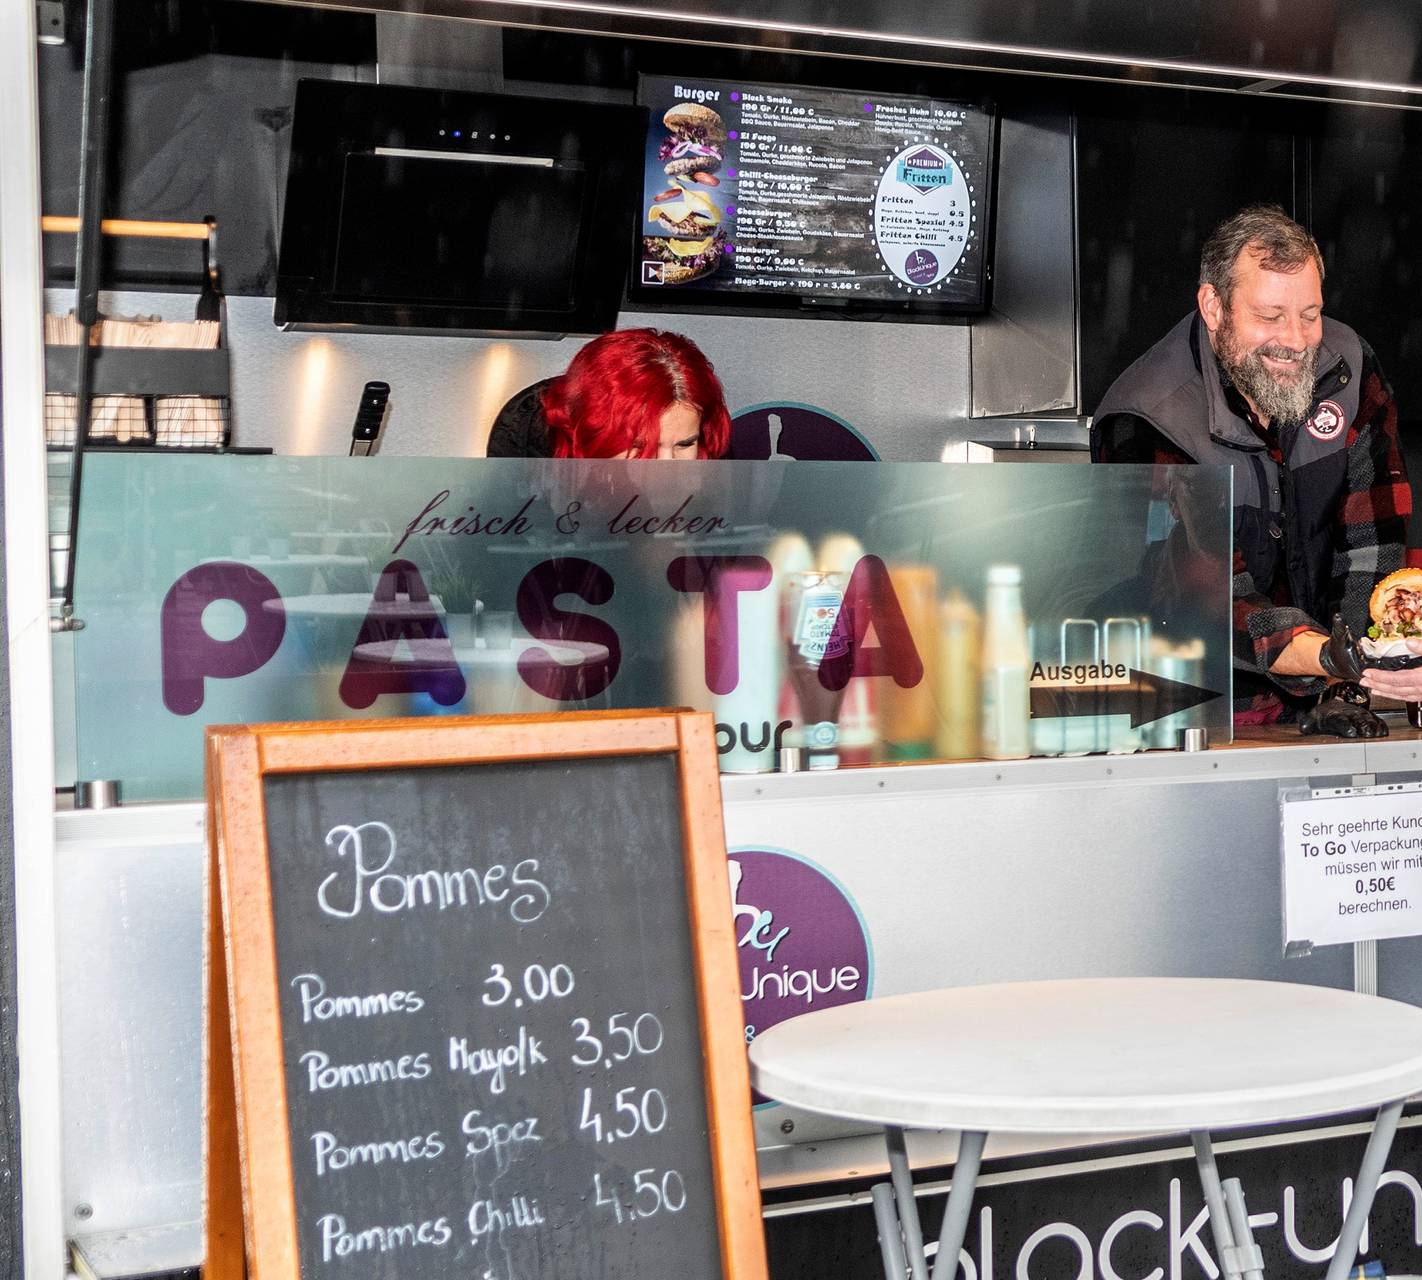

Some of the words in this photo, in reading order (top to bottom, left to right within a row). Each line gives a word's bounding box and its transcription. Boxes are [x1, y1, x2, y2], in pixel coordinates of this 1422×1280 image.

[674, 85, 720, 103] Burger
[752, 133, 776, 143] Fuego
[913, 159, 938, 167] PREMIUM
[903, 168, 947, 184] Fritten
[881, 196, 913, 204] Fritten
[881, 216, 913, 224] Fritten
[880, 231, 912, 239] Fritten
[736, 246, 779, 255] Hamburger
[395, 490, 537, 553] frisch
[556, 501, 581, 534] &
[608, 495, 729, 535] lecker
[160, 554, 925, 717] PASTA
[1030, 660, 1126, 684] Ausgabe
[1302, 822, 1334, 837] Sehr
[1338, 818, 1388, 837] geehrte
[1301, 843, 1319, 858] To
[1325, 841, 1346, 856] Go
[317, 820, 551, 922] Pommes
[1325, 859, 1377, 876] müssen
[1381, 859, 1398, 871] wir
[1355, 876, 1395, 895] 0,50€
[1338, 898, 1412, 915] berechnen.
[292, 973, 425, 1023] Pommes
[300, 1050, 432, 1092] Pommes
[310, 1130, 446, 1176] Pommes
[316, 1213, 452, 1262] Pommes
